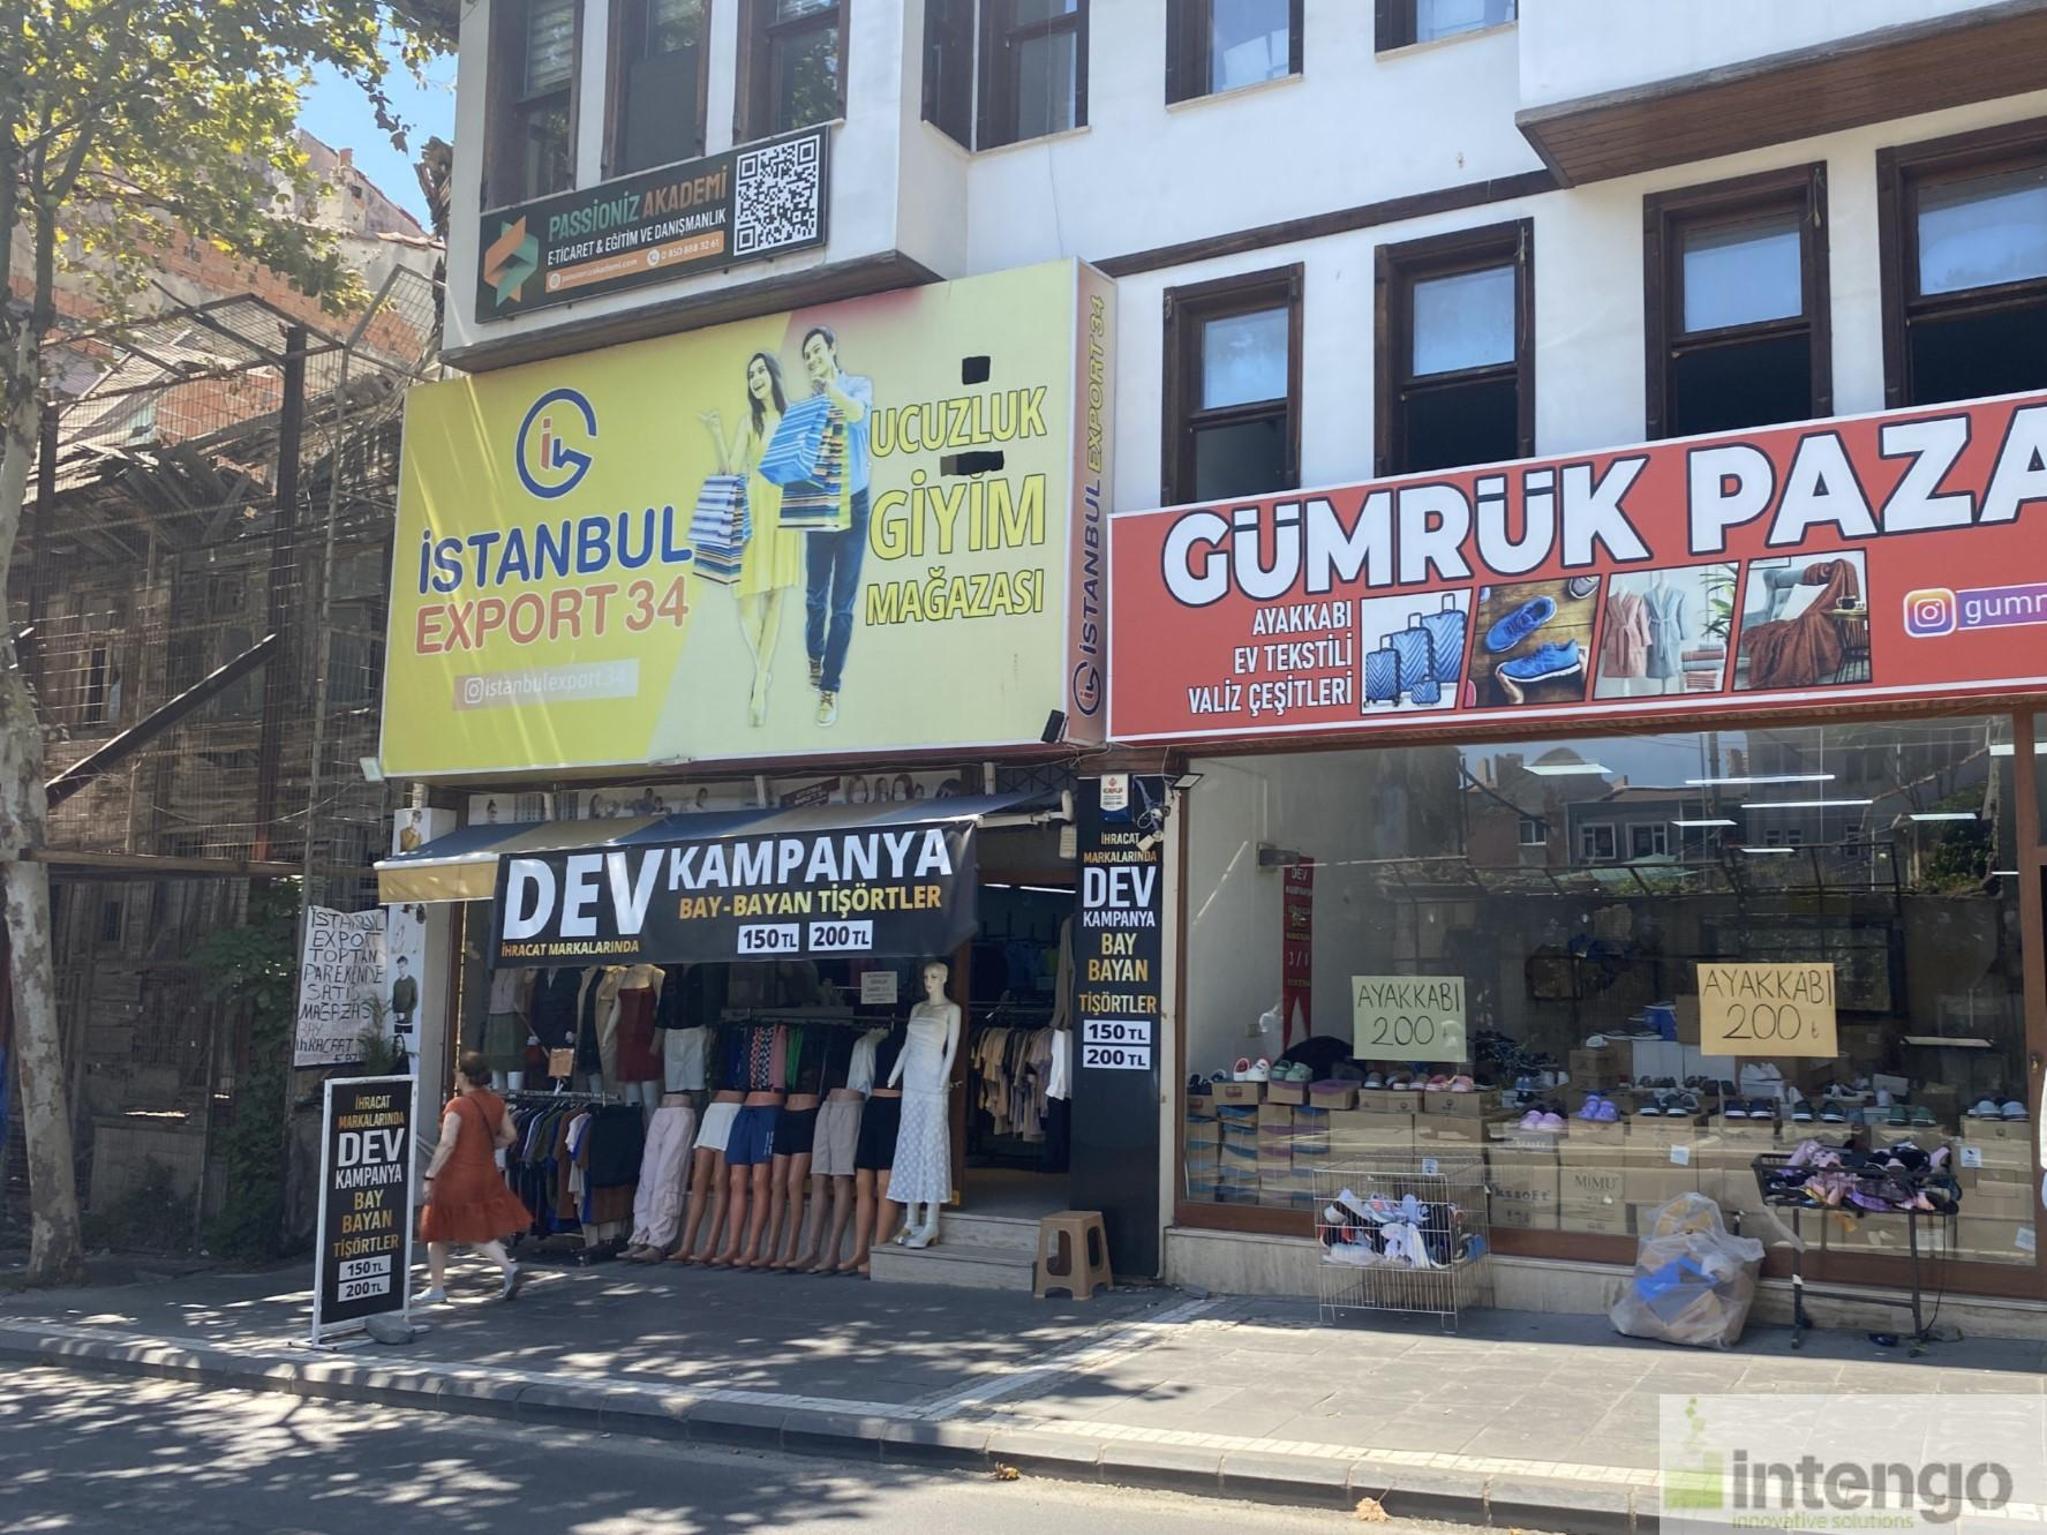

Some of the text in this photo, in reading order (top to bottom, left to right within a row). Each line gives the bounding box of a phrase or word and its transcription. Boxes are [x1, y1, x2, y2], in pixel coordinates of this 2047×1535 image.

[548, 165, 728, 242] PASSİONİZ AKADEMİ
[547, 207, 727, 266] E-TİCARET & EĞİTİM VE DANIŞMANLIK
[1087, 294, 1104, 473] EXPORT 34
[870, 386, 1047, 457] UCUZLUK
[869, 469, 1046, 561] GİYİM
[1161, 401, 2047, 607] GÜMRÜK PAZA
[419, 505, 693, 594] İSTANBUL
[1079, 479, 1100, 654] İSTANBUL
[866, 566, 1044, 626] MAĞAZASI
[416, 574, 689, 655] EXPORT 34
[1252, 599, 1352, 635] AYAKKABI
[1233, 633, 1352, 675] EV TEKSTİLİ
[1188, 670, 1352, 717] VALİZ ÇEŞİTLERİ
[1101, 831, 1140, 845] İHRACAT
[1083, 850, 1157, 864] MARKALARINDA
[503, 828, 952, 940] DEV KAMPANYA
[1082, 866, 1157, 908] DEV
[679, 883, 941, 920] BAY-BAYAN TİŞÖRTLER
[1083, 910, 1156, 928] KAMPANYA
[501, 940, 639, 957] İHRACAT MARKALARINDA
[743, 926, 869, 949] 150 TL 200 TL
[1101, 932, 1137, 956] BAY
[308, 948, 377, 964] TOPTAN
[1088, 959, 1148, 982] BAYAN
[1357, 983, 1459, 1012] AYAKKABI
[1702, 969, 1832, 1006] AYAKKABI
[1079, 991, 1157, 1015] TİŞÖRTLER
[1088, 1024, 1146, 1040] 150 TL
[1371, 1015, 1434, 1046] 200
[1722, 1003, 1801, 1039] 200
[1087, 1049, 1146, 1067] 200 TL
[355, 1094, 391, 1110] İHRACAT
[338, 1114, 404, 1131] MARKALARINDA
[337, 1128, 405, 1167] DEV
[335, 1163, 402, 1190] KAMPANYA
[354, 1189, 384, 1211] BAY
[342, 1209, 392, 1234] BAYAN
[333, 1234, 399, 1259] TİŞÖRTLER
[347, 1260, 383, 1275] 150 TL
[346, 1281, 383, 1297] 200 TL
